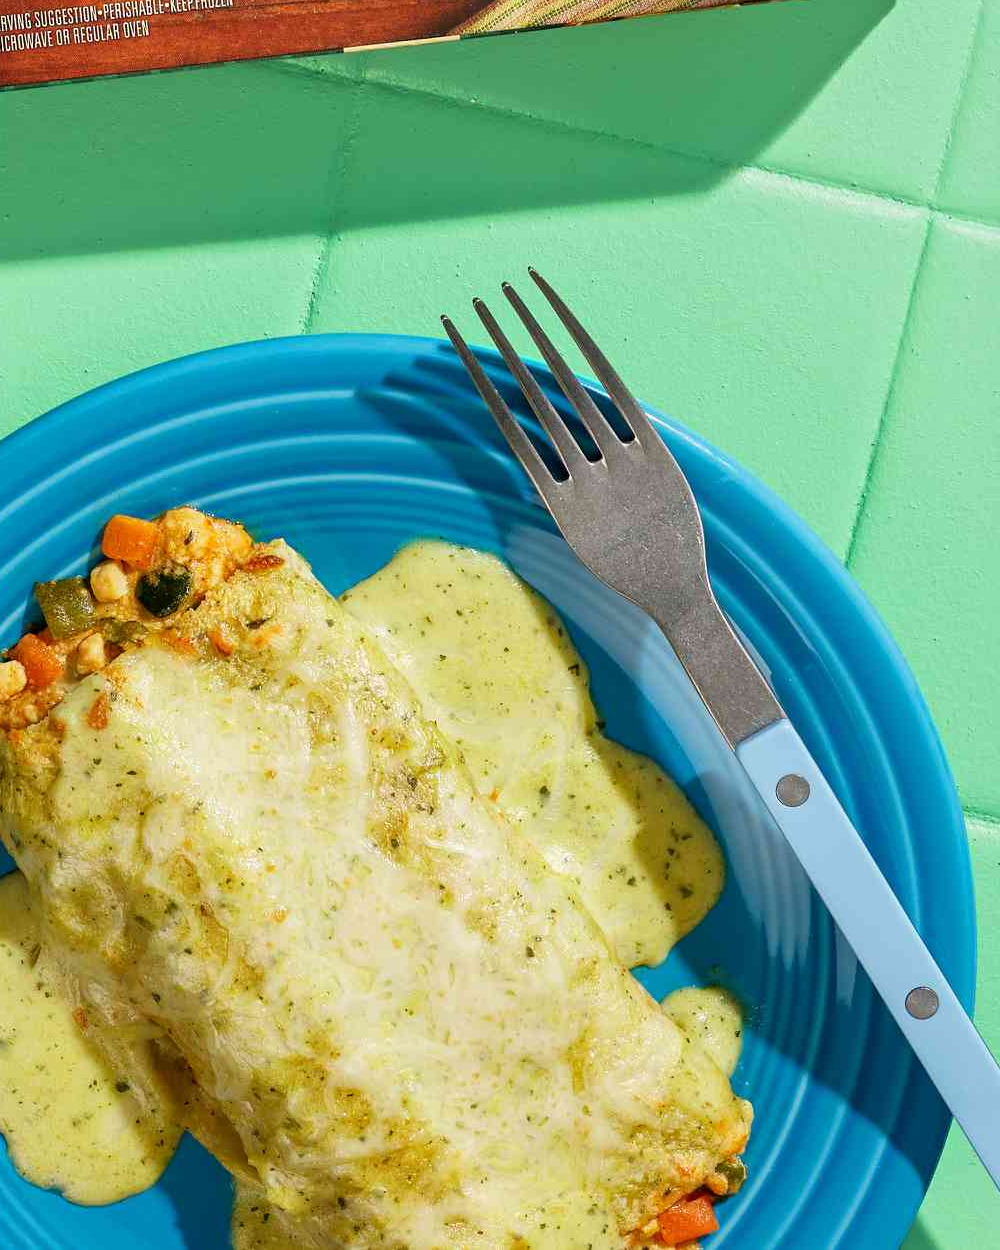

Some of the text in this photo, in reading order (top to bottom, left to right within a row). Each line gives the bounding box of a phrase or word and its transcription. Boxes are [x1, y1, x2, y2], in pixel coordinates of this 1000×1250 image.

[55, 28, 71, 47] OR
[73, 22, 121, 45] REGULAR
[122, 19, 150, 39] OVEN
